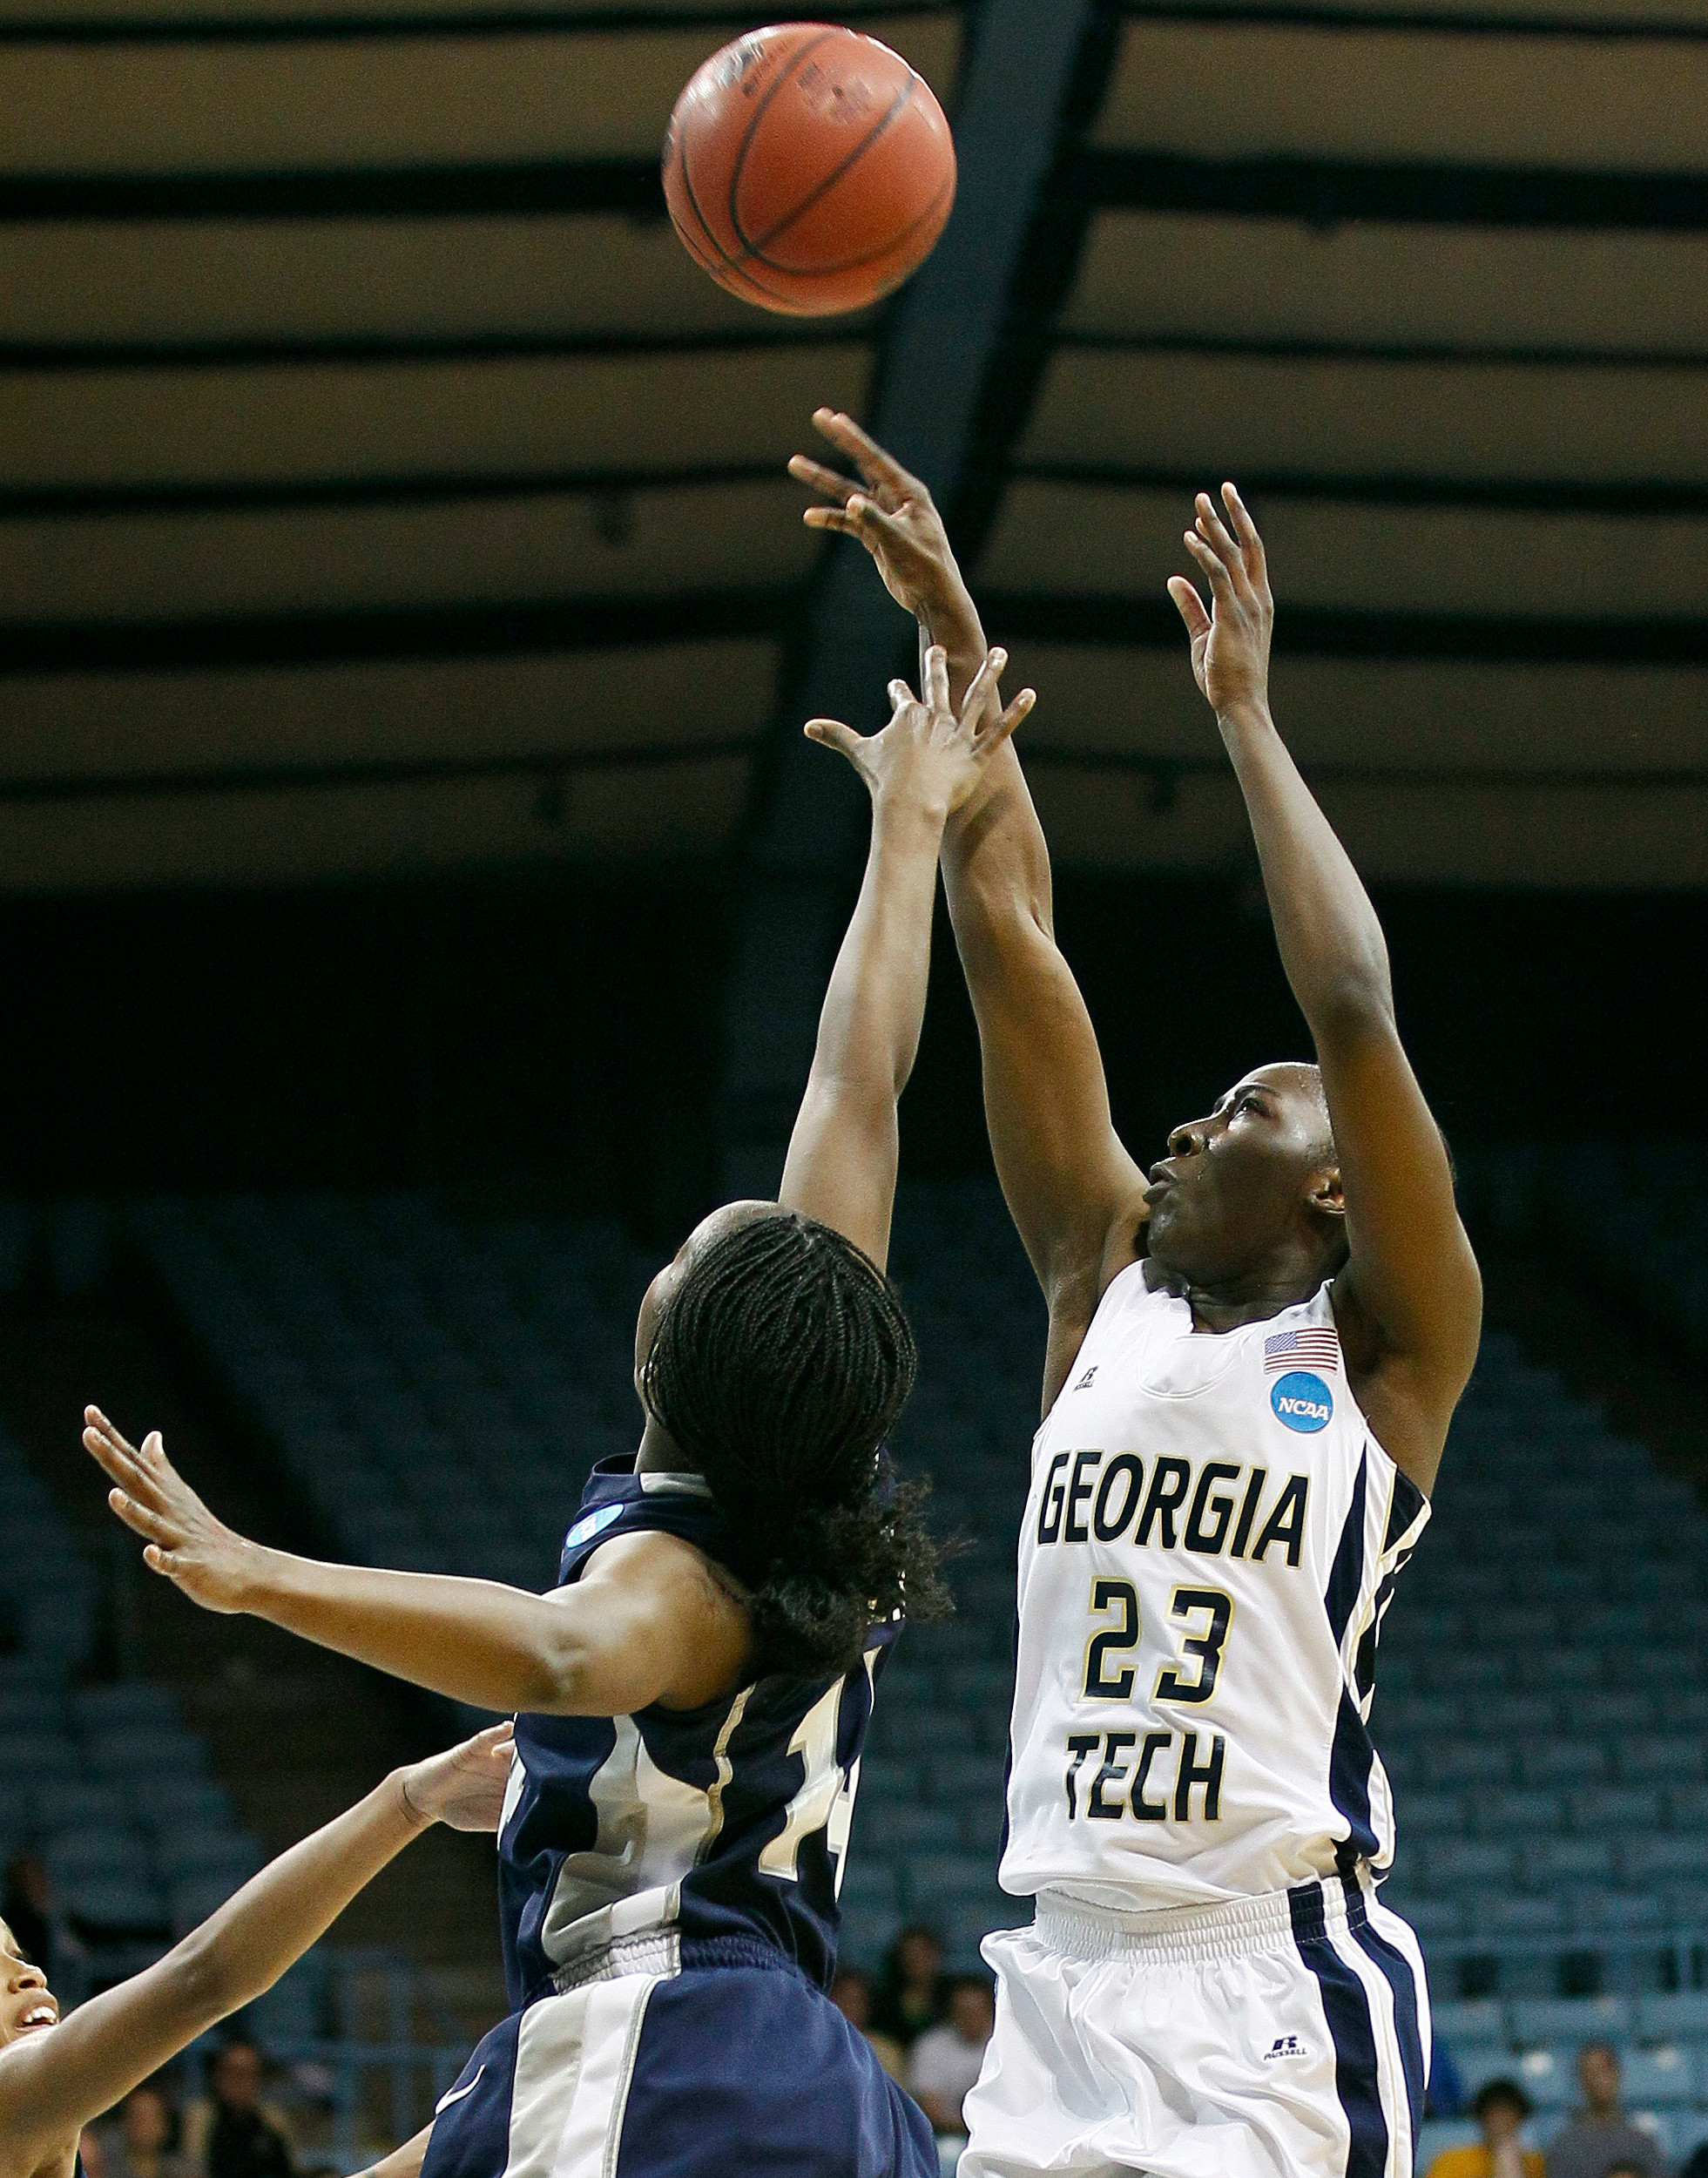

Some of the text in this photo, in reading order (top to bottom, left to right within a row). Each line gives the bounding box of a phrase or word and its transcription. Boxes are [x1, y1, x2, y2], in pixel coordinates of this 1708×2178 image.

[1278, 1397, 1328, 1421] NCAA
[1036, 1450, 1310, 1569] GEORGIA
[1079, 1575, 1234, 1708] 23
[1065, 1729, 1226, 1823] TECH
[1264, 2048, 1306, 2060] RUSSELL
